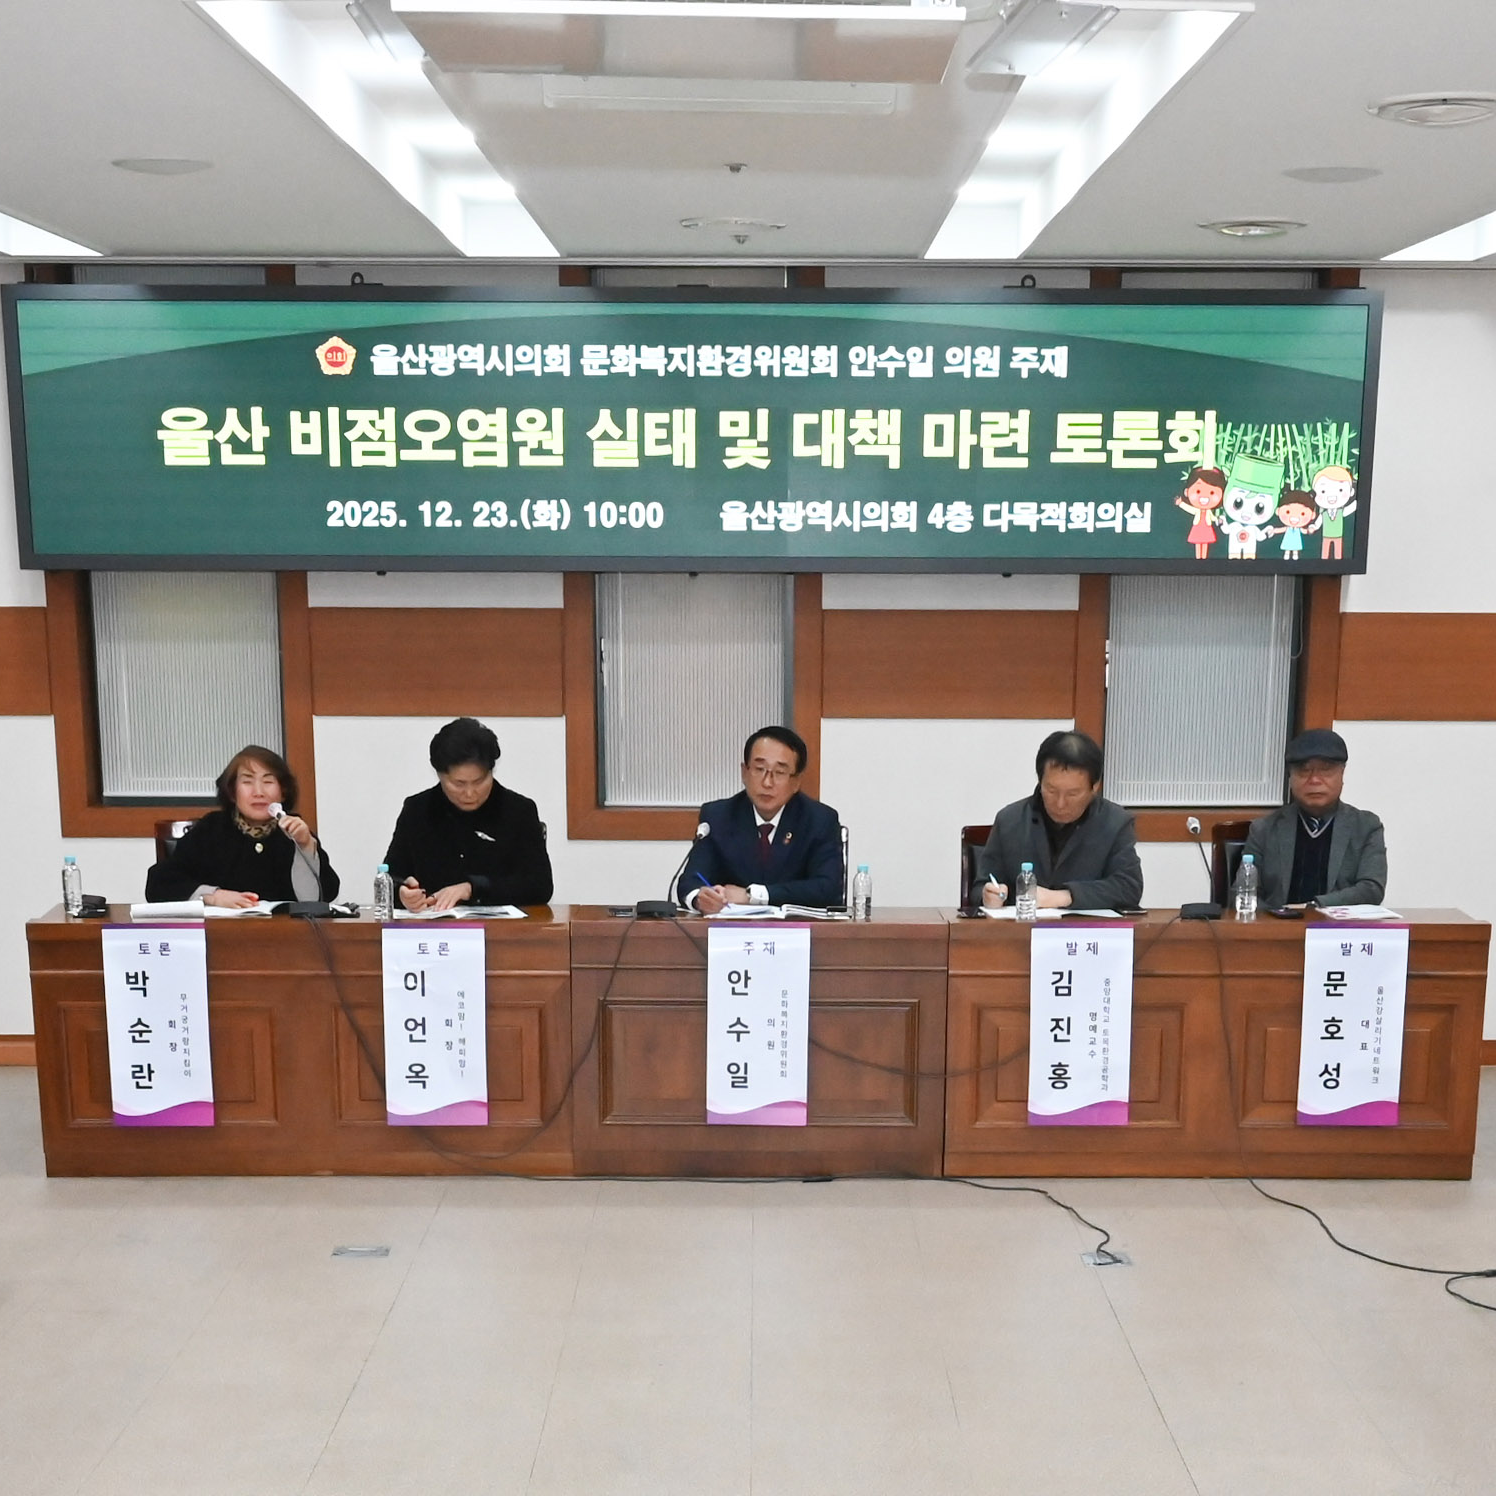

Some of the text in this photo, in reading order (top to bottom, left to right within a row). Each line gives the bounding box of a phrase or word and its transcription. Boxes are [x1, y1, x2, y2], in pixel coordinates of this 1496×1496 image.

[326, 350, 347, 362] 의회
[369, 343, 1069, 379] 울산광역시의회 문화복지환경위원회 안수일 의원 주재
[156, 406, 1217, 472] 울산 비점오염원 실태 및 대책 마련 토론회
[326, 498, 664, 531] 2025. 12. 23.(화) 10:00
[719, 500, 1153, 534] 울산광역시의회 4층 다목적회의실
[138, 942, 172, 956] 토론
[417, 942, 450, 956] 토론
[743, 941, 776, 956] 주재
[1066, 941, 1099, 956] 발제
[1340, 942, 1374, 956] 발제
[125, 970, 155, 1090] 박순란
[404, 970, 430, 1090] 이언옥
[726, 969, 752, 1089] 안수일
[1047, 970, 1073, 1090] 김진홍
[1318, 970, 1348, 1090] 문호성
